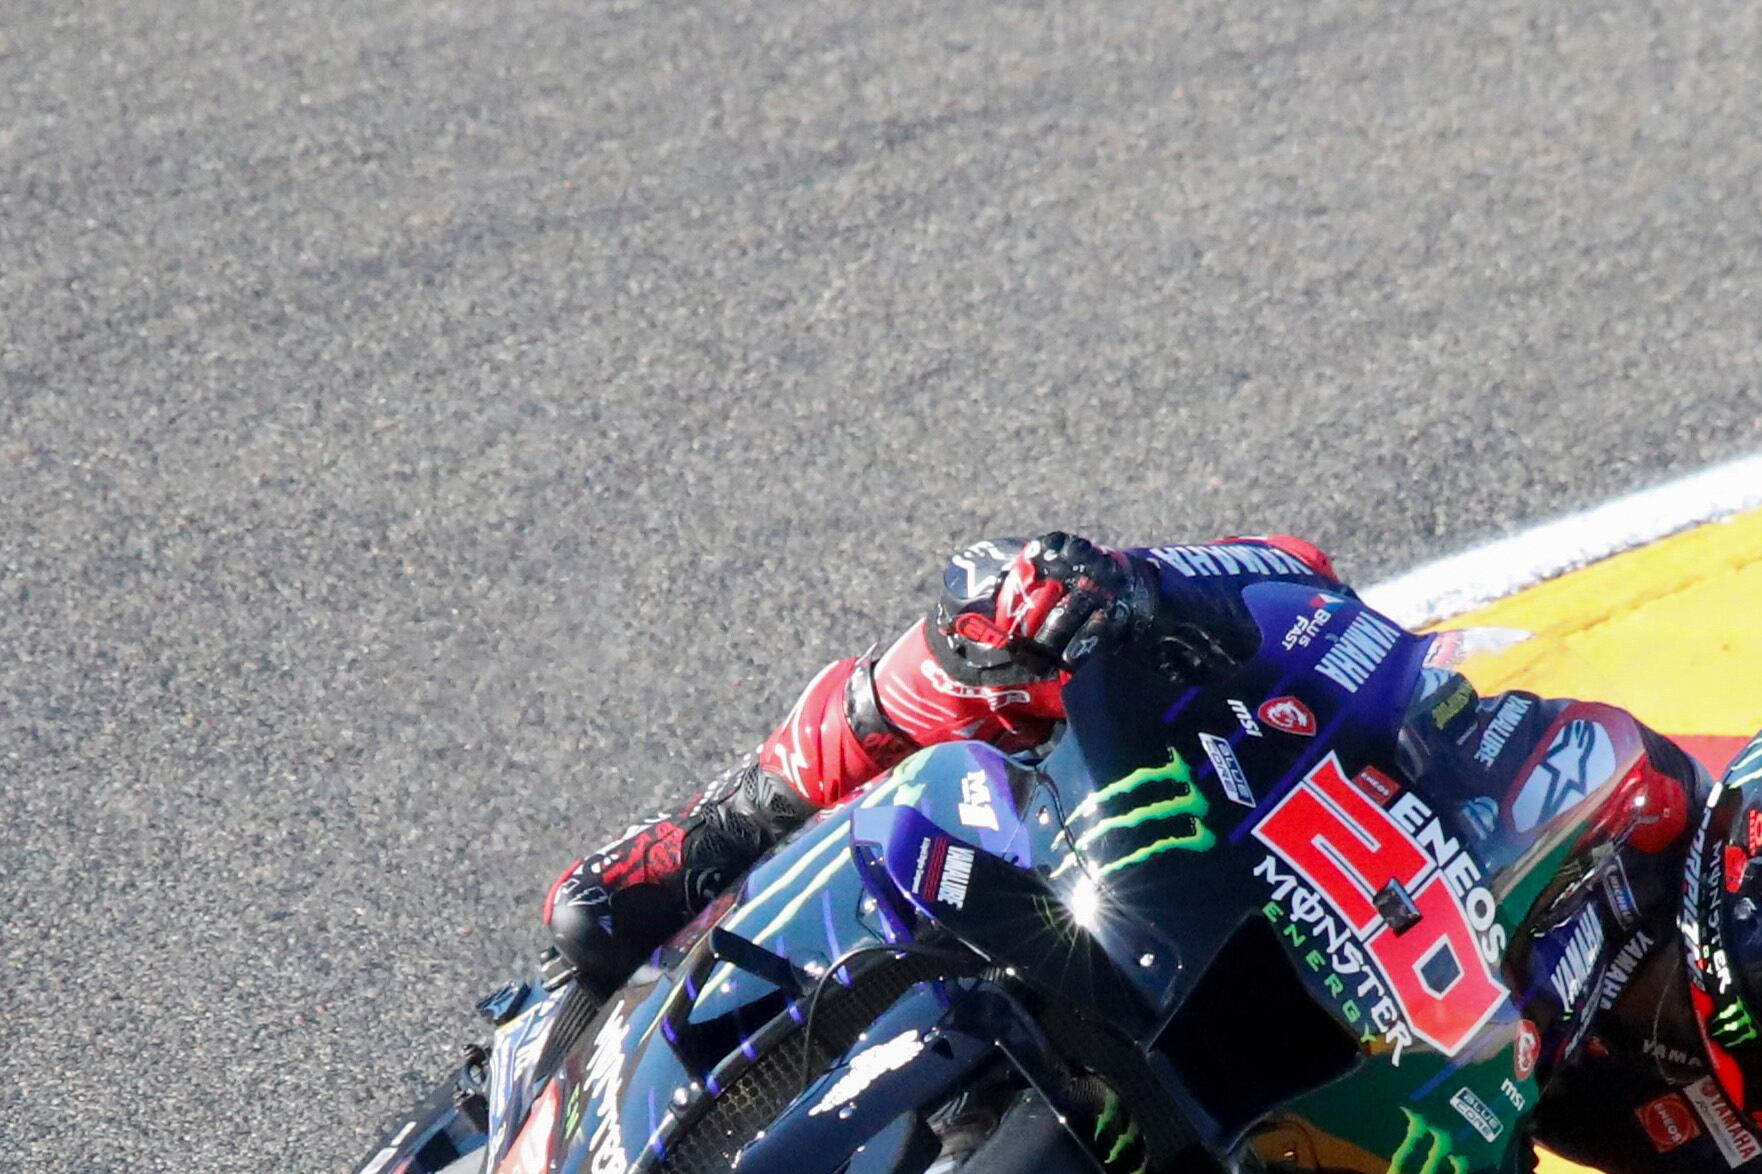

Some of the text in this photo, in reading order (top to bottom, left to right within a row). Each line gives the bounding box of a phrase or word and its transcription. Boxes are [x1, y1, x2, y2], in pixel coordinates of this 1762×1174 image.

[1150, 544, 1314, 578] YAMAHA
[1281, 614, 1304, 652] FAST
[1314, 610, 1401, 694] YAMAHA
[1473, 694, 1533, 768] YAMALUBE
[957, 768, 1000, 832] M1
[1359, 771, 1391, 798] ENEOS
[936, 845, 976, 911] YAMALUBE
[1388, 791, 1507, 964] ENEOS
[1253, 854, 1413, 1068] MONSTER
[1261, 901, 1377, 1044] ENERGY
[1462, 1092, 1499, 1129] BLUE
[1710, 1093, 1757, 1160] YAMAHA
